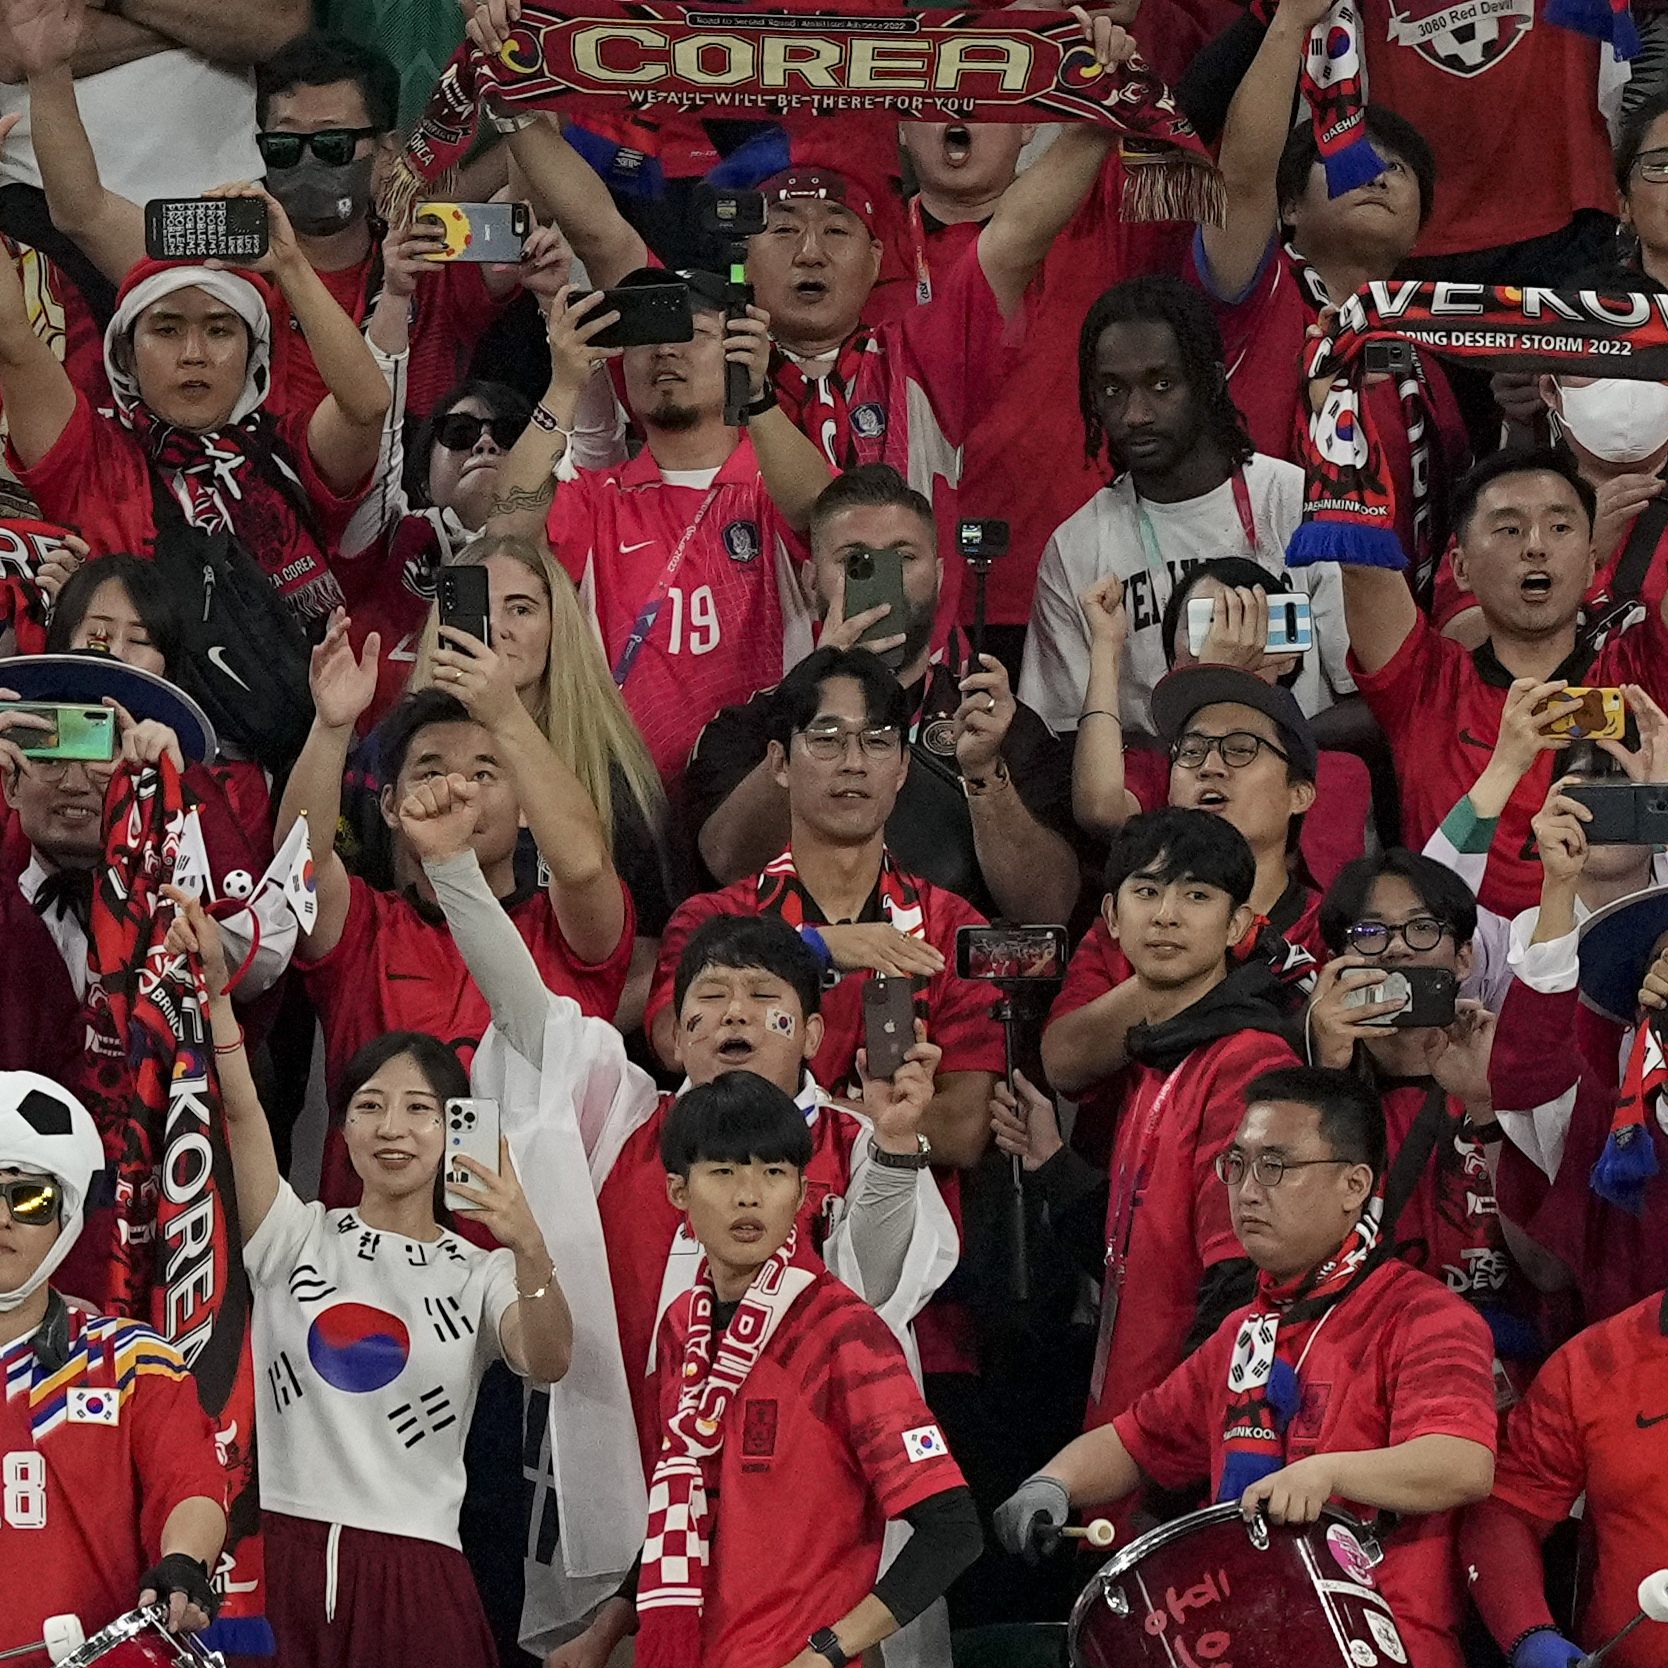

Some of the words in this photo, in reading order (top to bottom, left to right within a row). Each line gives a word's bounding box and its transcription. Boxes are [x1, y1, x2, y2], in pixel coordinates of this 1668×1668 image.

[1417, 16, 1447, 38] 3080
[1449, 6, 1477, 26] Red
[570, 24, 1034, 93] COREA
[628, 88, 658, 105] WE
[668, 90, 705, 107] ALL
[714, 91, 768, 108] WILL
[777, 94, 802, 109] BE
[811, 94, 872, 110] THERE
[884, 96, 923, 111] FOR
[934, 97, 975, 112] YOU
[1450, 330, 1518, 349] DESERT
[1521, 333, 1583, 351] STORM
[1587, 339, 1633, 357] 2022
[667, 587, 723, 655] 19
[166, 1072, 214, 1369] KOREA
[2, 1449, 47, 1530] 8
